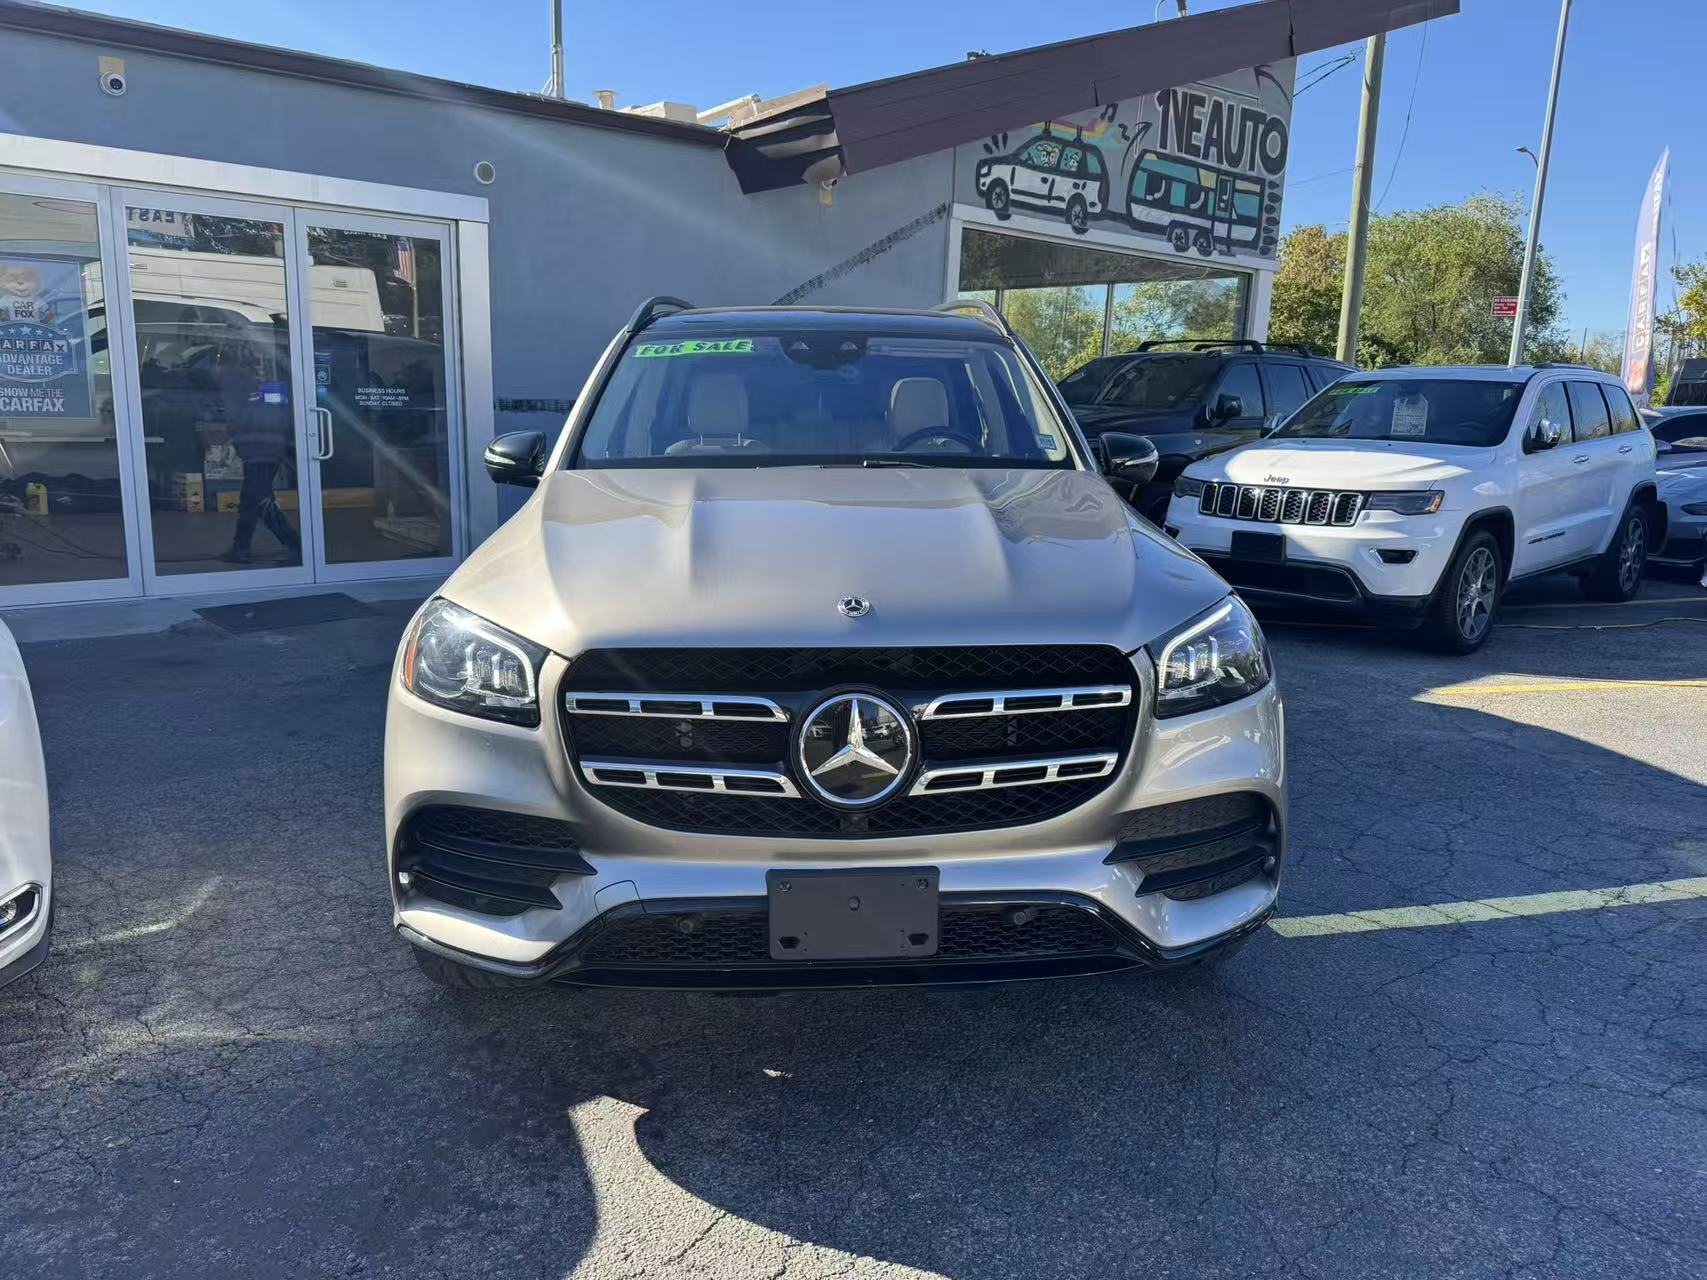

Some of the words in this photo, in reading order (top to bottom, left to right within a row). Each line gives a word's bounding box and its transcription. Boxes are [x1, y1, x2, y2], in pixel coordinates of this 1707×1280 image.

[13, 301, 34, 309] CAR
[14, 310, 34, 318] FOX
[0, 340, 66, 352] ARFAX
[640, 342, 685, 355] FOR
[693, 340, 750, 352] SALE
[7, 364, 53, 376] DEALER
[30, 388, 46, 397] ME
[46, 388, 64, 398] THE
[0, 398, 65, 412] CARFAX
[1263, 474, 1290, 484] Jeep
